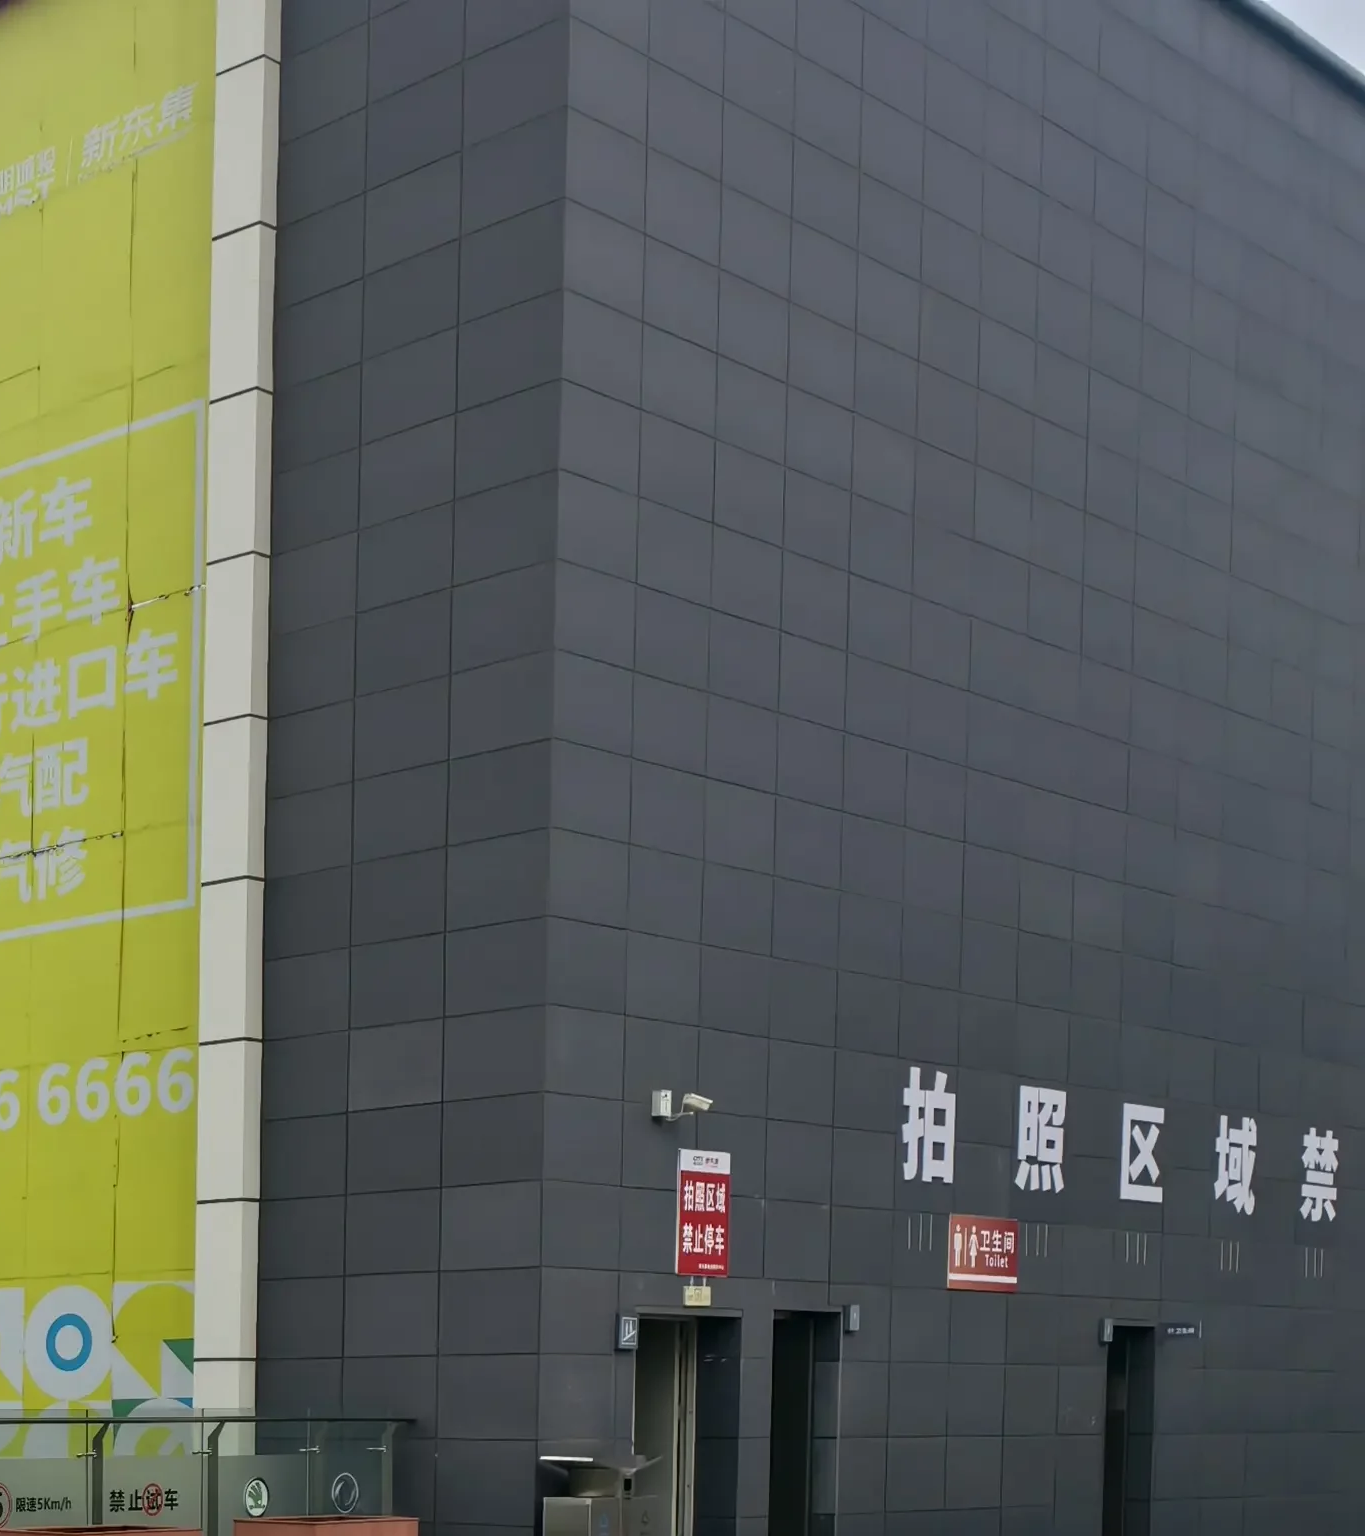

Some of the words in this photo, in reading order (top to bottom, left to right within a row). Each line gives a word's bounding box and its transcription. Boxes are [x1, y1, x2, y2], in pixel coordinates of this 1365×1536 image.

[36, 1048, 195, 1125] 6666
[684, 1180, 725, 1213] 拍照区域
[682, 1223, 725, 1256] 禁止停车
[979, 1230, 1014, 1254] 卫生间
[985, 1254, 1008, 1268] Toilet
[15, 1496, 72, 1513] 限速5Km/h
[109, 1488, 179, 1513] 禁止试车
